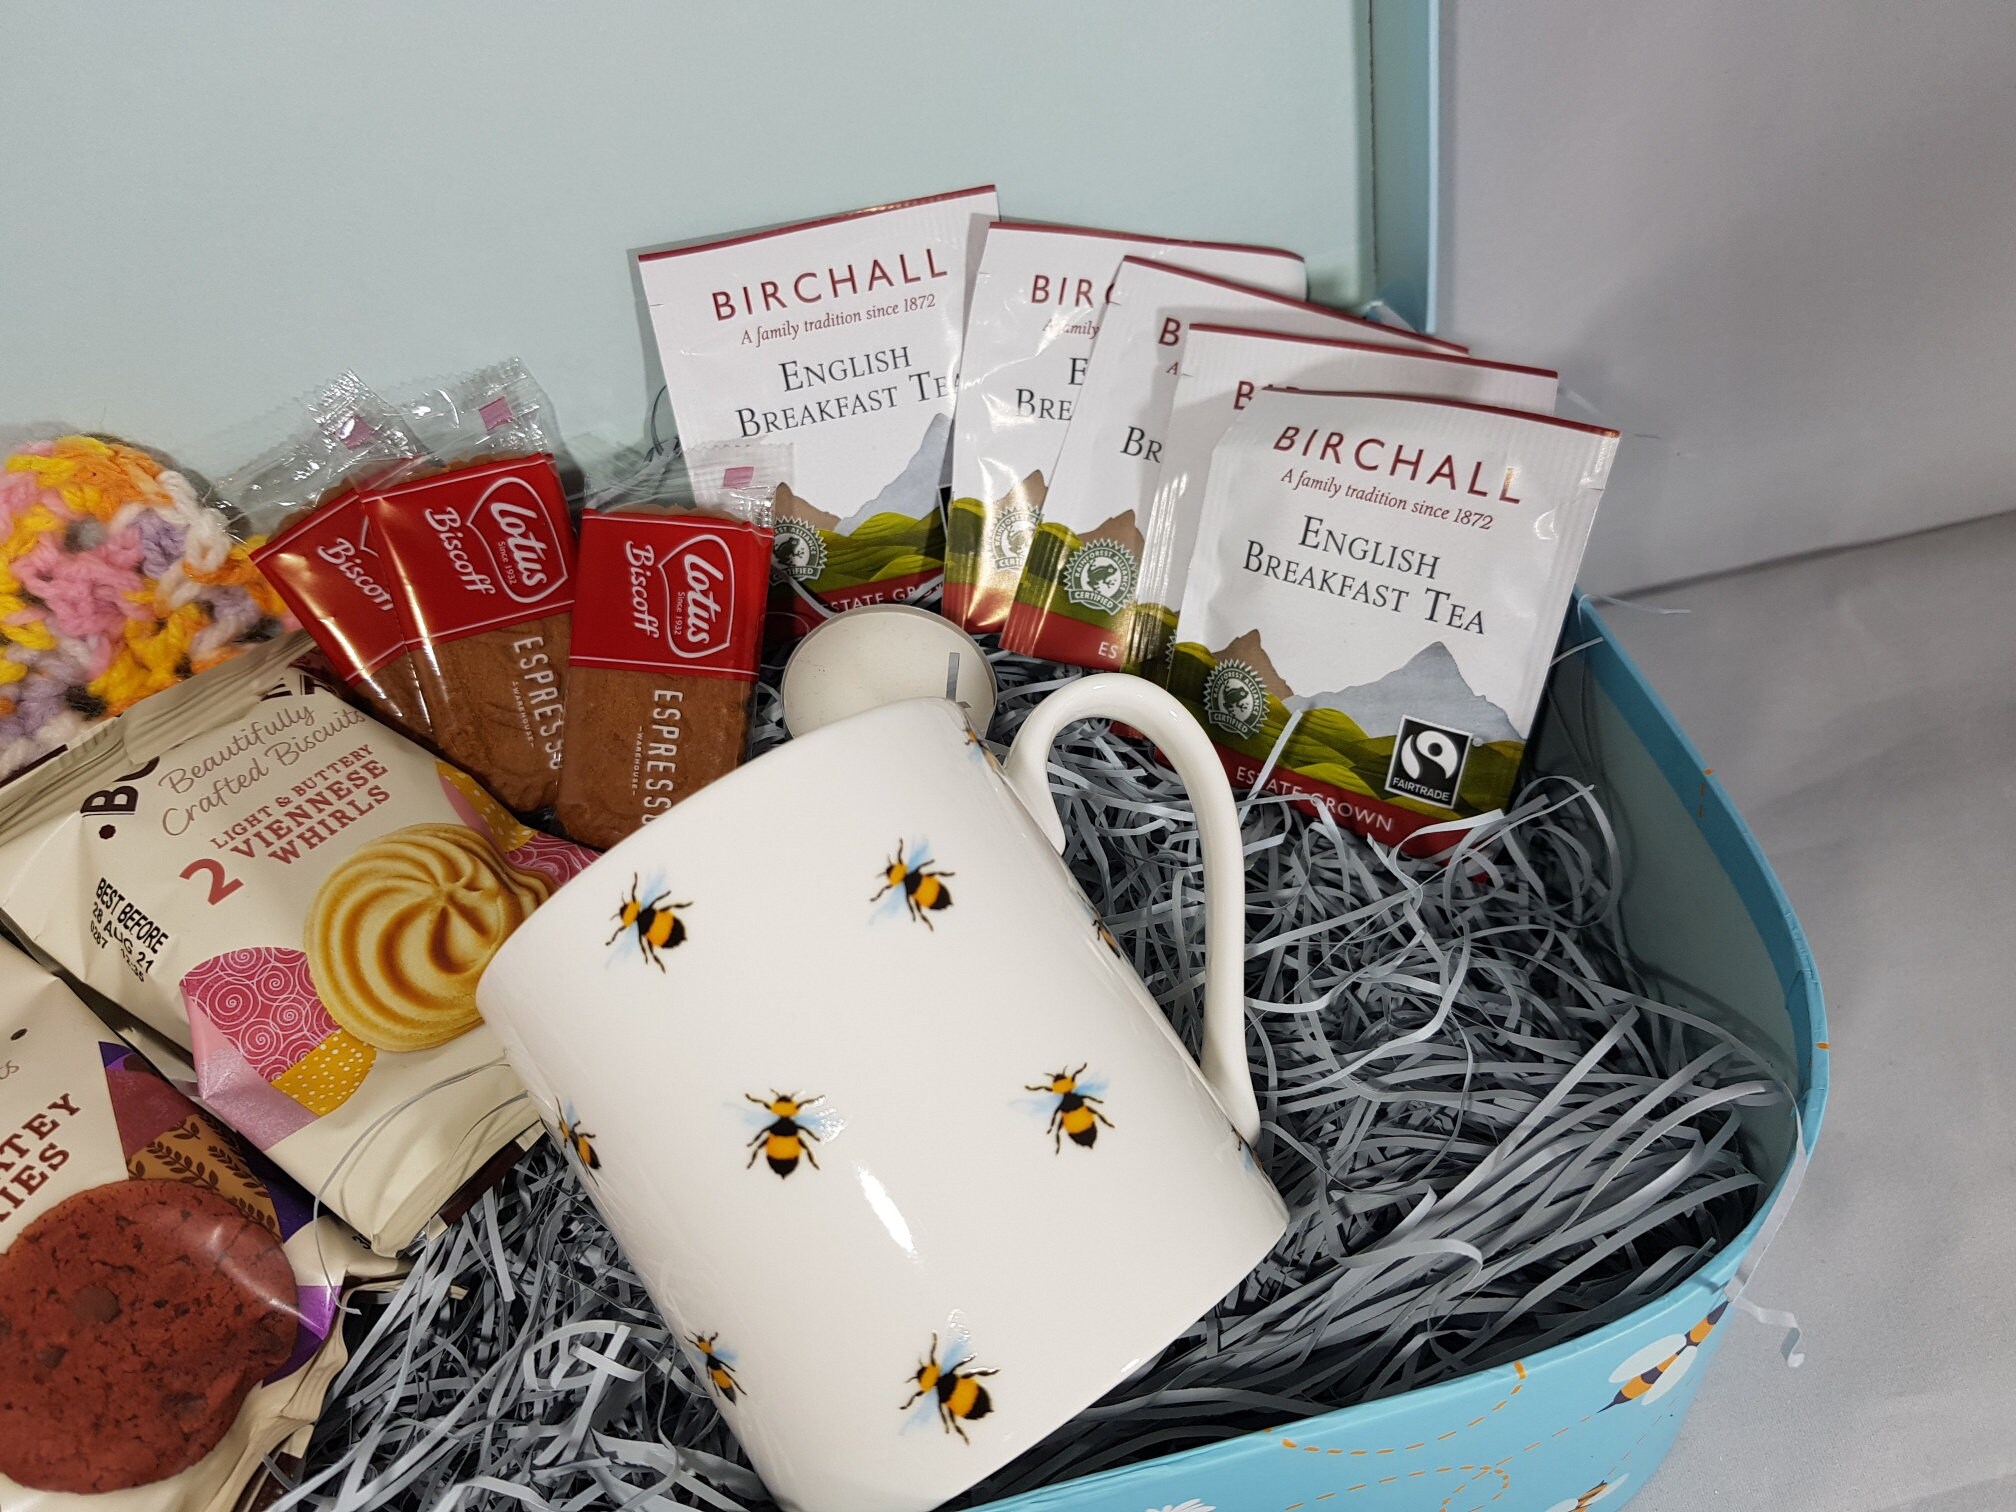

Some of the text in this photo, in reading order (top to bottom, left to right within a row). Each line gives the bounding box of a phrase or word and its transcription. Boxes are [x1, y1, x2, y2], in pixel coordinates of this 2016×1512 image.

[712, 249, 948, 321] BIRCHALL
[741, 294, 936, 347] A family tradition since 1872
[779, 346, 912, 392] ENGLISH
[735, 386, 898, 438] BREAKFAST
[1273, 426, 1521, 504] BIRCHALL
[1280, 468, 1494, 530] A family tradition since 1872
[424, 506, 496, 596] Biscoff
[490, 501, 548, 587] Lotus
[497, 540, 518, 585] Since 1932
[1298, 515, 1440, 580] ENGLISH
[625, 540, 660, 638] Biscoff
[674, 591, 686, 635] Since 1932
[684, 553, 724, 645] Lotus
[1074, 591, 1114, 608] CERTIFIED
[1242, 540, 1485, 634] BREAKFAST TEA
[158, 705, 315, 794] Beautifully
[1213, 713, 1249, 733] CERTIFIED
[162, 708, 366, 836] Crafted Biscuits
[210, 744, 375, 850] LIGHT & BUTTERY
[1392, 777, 1451, 801] FAIRTRADE
[230, 759, 389, 858] VIENNESE
[268, 785, 391, 865] WHIRLS
[95, 877, 169, 954] BEST BEFORE
[179, 858, 244, 906] 2
[90, 920, 109, 949] 0287
[92, 902, 154, 975] 28 AUG 21
